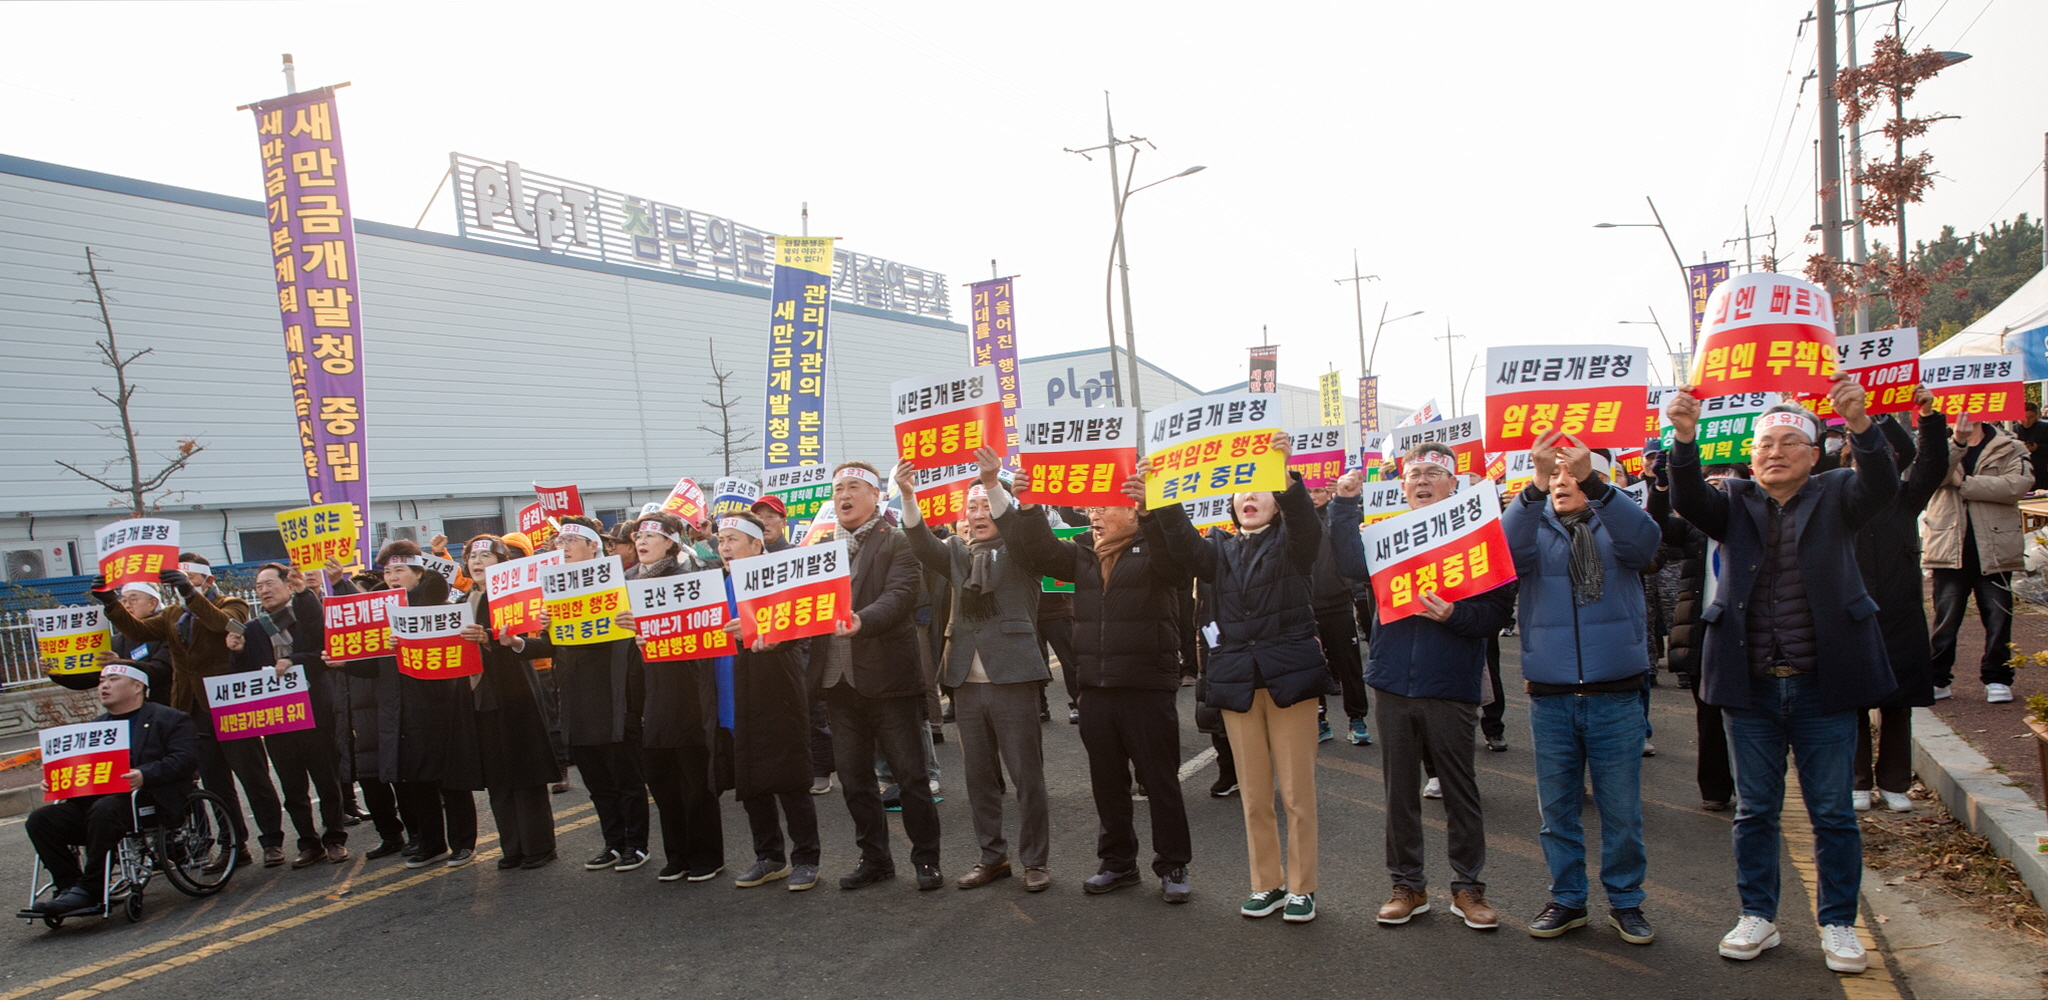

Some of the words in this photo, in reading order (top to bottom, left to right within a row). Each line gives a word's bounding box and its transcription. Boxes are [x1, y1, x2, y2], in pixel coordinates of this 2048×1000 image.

[289, 101, 356, 376] 새만금개발청
[259, 109, 299, 314] 새만금기본계획
[285, 324, 320, 479] 새만금신항
[1769, 284, 1830, 322] 빠르게
[974, 291, 991, 340] 기대를
[994, 283, 1013, 350] 기울어진
[798, 284, 828, 398] 관리기관의
[1859, 335, 1894, 361] 주장
[1496, 354, 1633, 385] 새만금개발청
[1765, 340, 1841, 376] 무책임
[1920, 360, 2013, 384] 새만금개발청
[767, 299, 797, 464] 새만금개발청은
[998, 358, 1018, 409] 행정을
[1867, 362, 1915, 387] 100점
[896, 374, 985, 416] 새만금개발청
[1881, 383, 1917, 405] 0점
[1024, 416, 1124, 446] 새만금개발청
[1150, 399, 1268, 443] 새만금개발청
[1500, 400, 1623, 439] 엄정중립
[1705, 416, 1746, 438] 원칙에
[1780, 413, 1804, 429] 유지
[319, 396, 360, 482] 중립
[901, 419, 984, 461] 엄정중립
[1699, 440, 1733, 461] 계획
[1149, 439, 1223, 478] 무책임한
[1229, 432, 1273, 458] 행정
[1323, 460, 1341, 479] 유지
[1430, 451, 1450, 468] 유지
[767, 467, 826, 488] 새만금신항
[846, 468, 865, 479] 유지
[1030, 462, 1116, 494] 엄정중립
[1162, 471, 1201, 500] 즉각
[1209, 462, 1257, 490] 중단
[664, 495, 700, 518] 중립
[790, 487, 814, 503] 원칙에
[814, 484, 832, 498] 따른
[786, 503, 806, 517] 계획
[101, 524, 170, 552] 새만금개발청
[281, 515, 309, 544] 공정성
[314, 510, 340, 535] 없는
[1374, 493, 1482, 563] 새만금개발청
[105, 553, 165, 585] 엄정중립
[491, 566, 521, 596] 항의엔
[542, 562, 611, 594] 새만금개발청
[743, 549, 838, 592] 새만금개발청
[1389, 541, 1490, 608] 엄정중립
[589, 591, 619, 615] 행정
[643, 586, 667, 609] 군산
[672, 579, 702, 604] 주장
[392, 610, 463, 634] 새만금개발청
[492, 600, 524, 631] 계획엔
[555, 623, 575, 641] 즉각
[580, 616, 611, 639] 중단
[639, 615, 683, 639] 받아쓰기
[686, 605, 724, 630] 100점
[755, 592, 837, 635] 엄정중립
[75, 633, 104, 650] 행정
[644, 633, 698, 660] 현실행정
[702, 628, 728, 650] 0점
[64, 653, 96, 671] 중단
[400, 645, 463, 671] 엄정중립
[214, 671, 299, 702] 새만금신항
[219, 706, 284, 734] 새만금기본계획
[286, 702, 305, 724] 유지
[44, 727, 118, 756] 새만금개발청
[50, 761, 114, 792] 엄정중립
